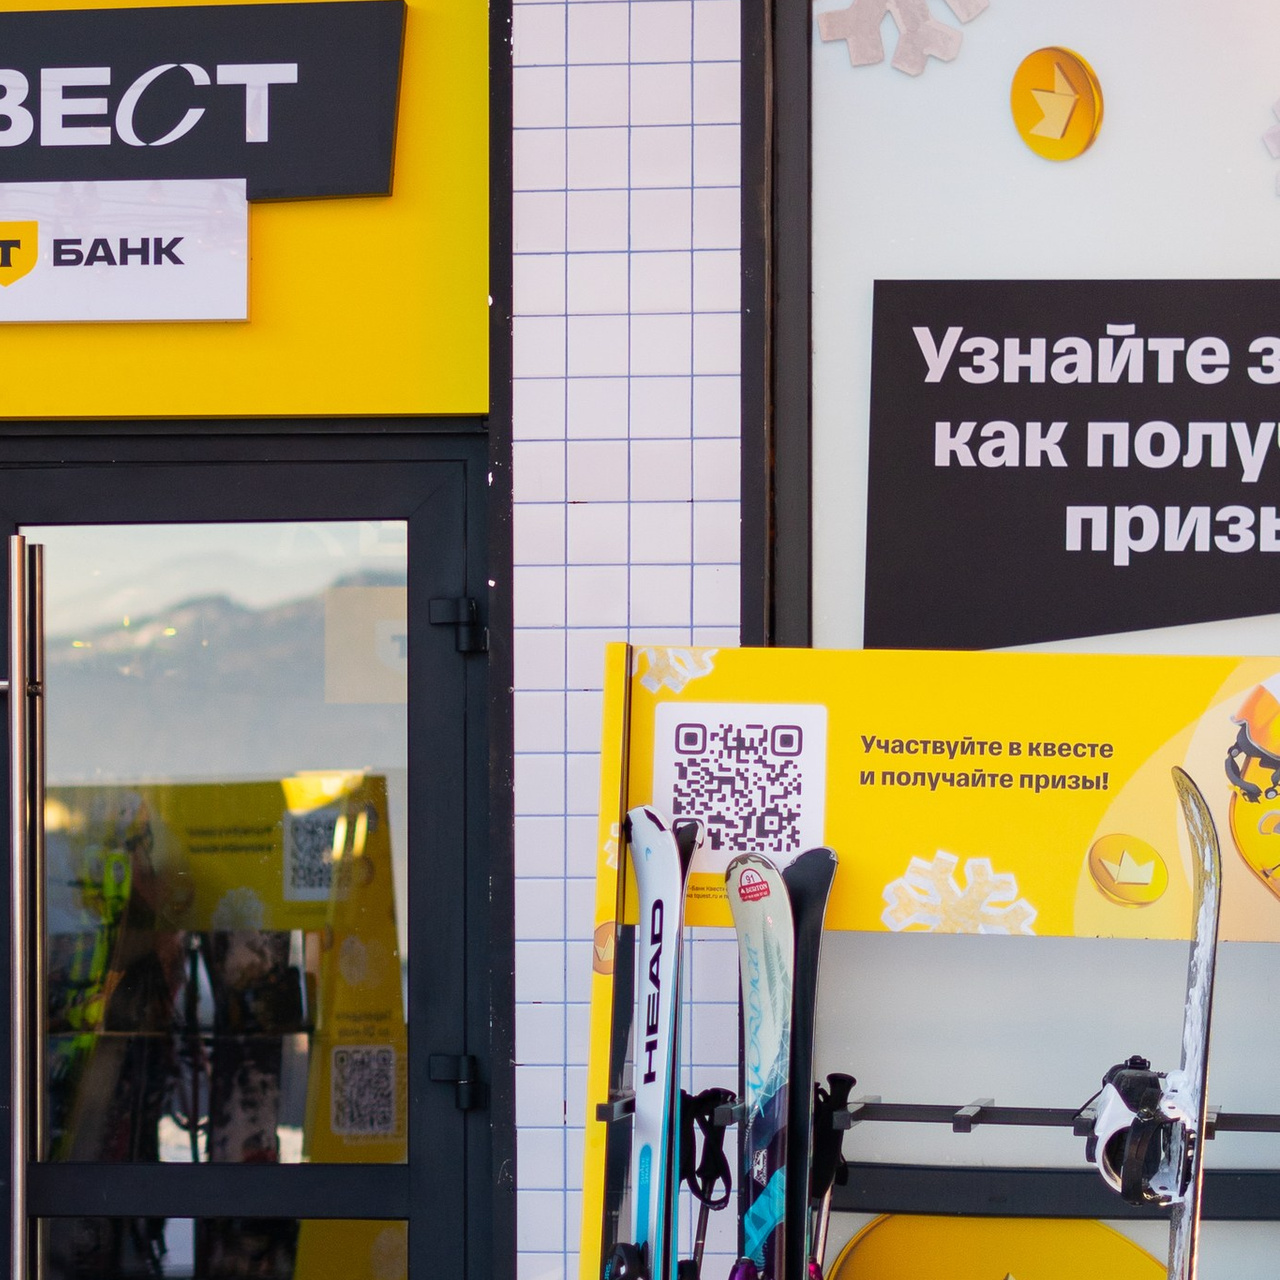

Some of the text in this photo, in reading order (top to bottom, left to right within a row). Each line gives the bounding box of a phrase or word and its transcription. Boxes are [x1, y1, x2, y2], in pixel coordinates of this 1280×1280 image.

[52, 236, 185, 267] БАНК
[912, 323, 1230, 385] Узнайте
[934, 420, 1280, 483] как полу
[860, 735, 1114, 759] Участвуйте в квесте
[860, 768, 1109, 793] и получайте призы!
[643, 898, 664, 1086] HEAD
